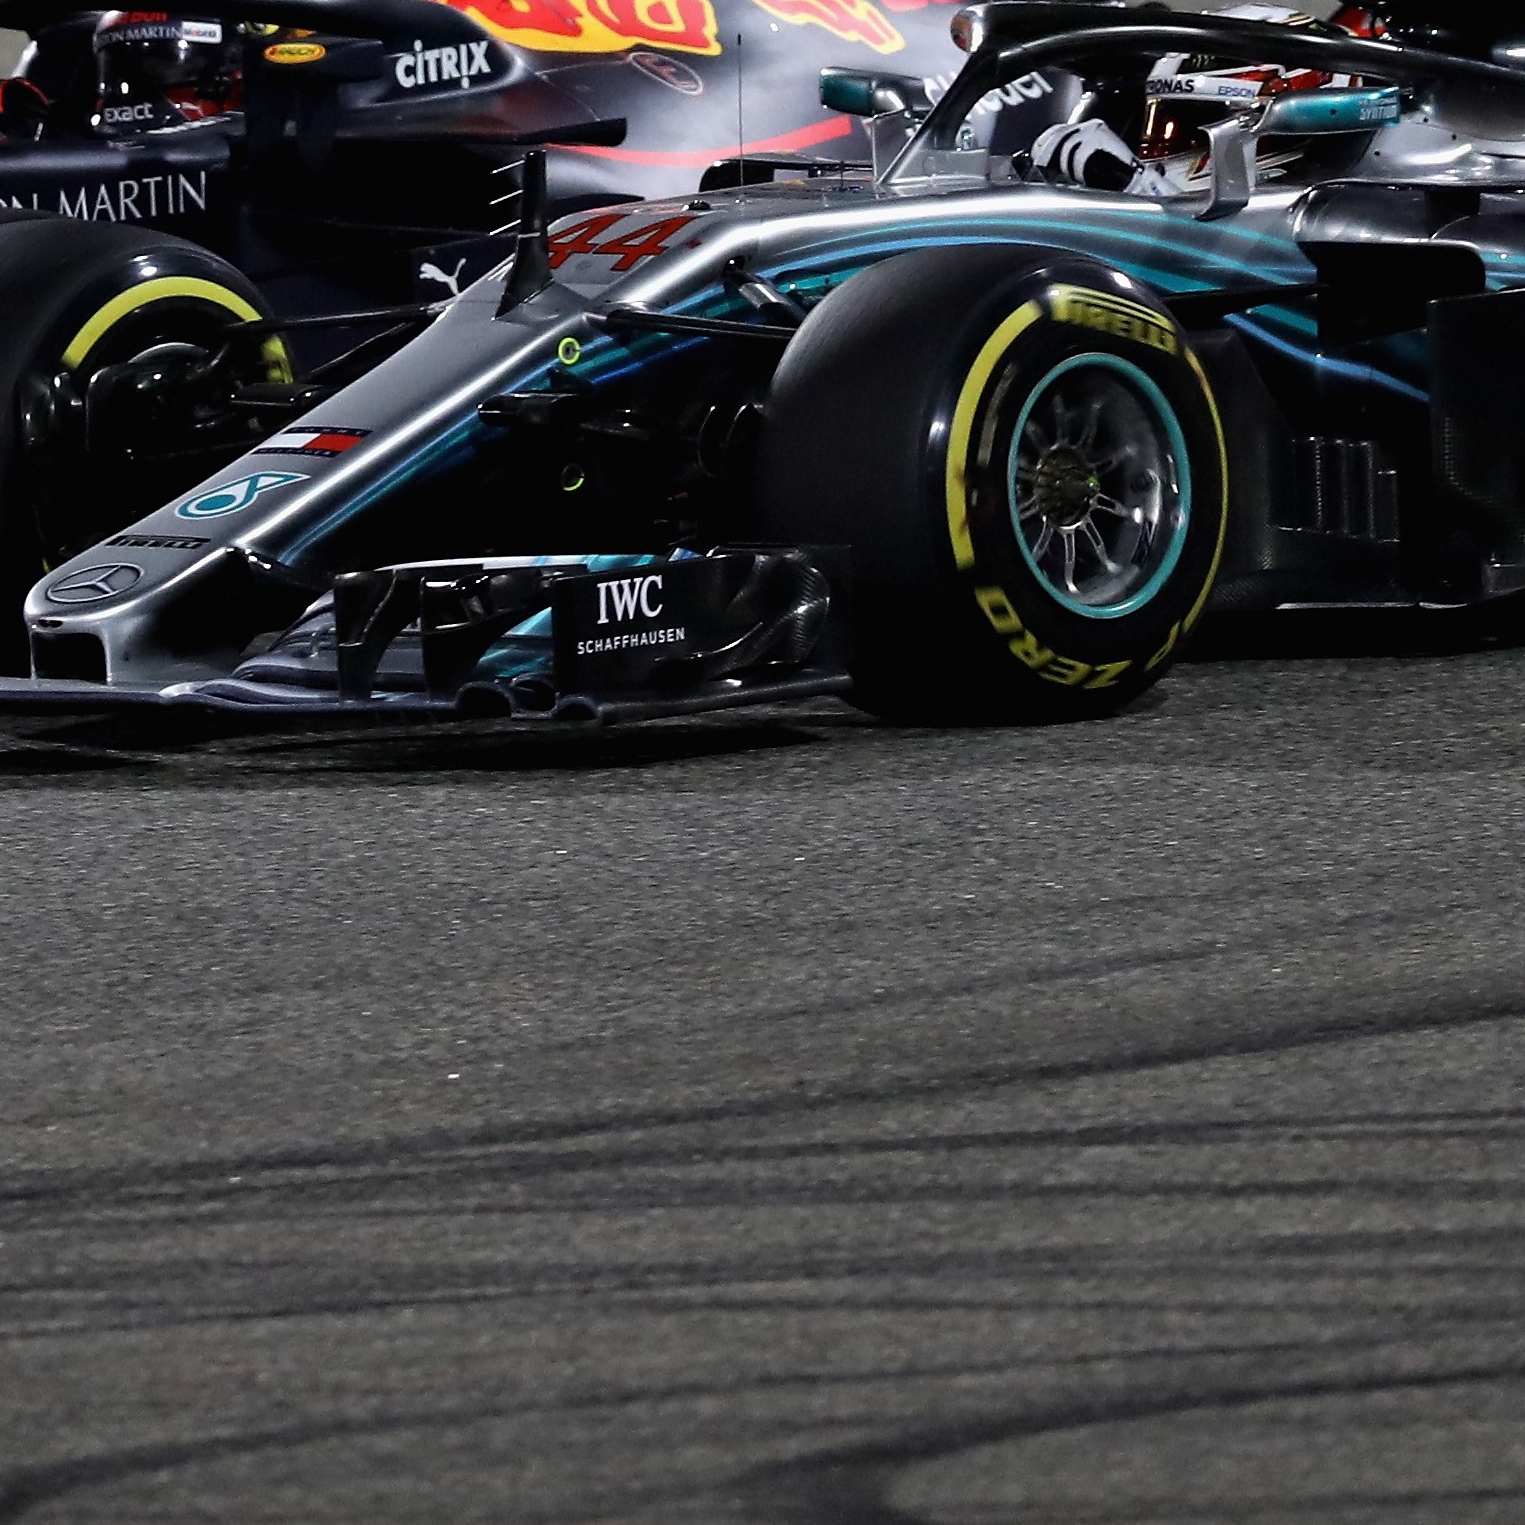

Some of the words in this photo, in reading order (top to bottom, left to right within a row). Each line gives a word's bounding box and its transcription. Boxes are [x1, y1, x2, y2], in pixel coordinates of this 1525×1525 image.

[1218, 85, 1256, 98] EPSON
[58, 170, 207, 223] MARTIN
[548, 213, 704, 271] 44
[105, 534, 212, 549] PIRELLI
[596, 575, 664, 625] IWC
[577, 627, 686, 655] SCHAFFHAUSEN
[975, 585, 1134, 690] ZERO
